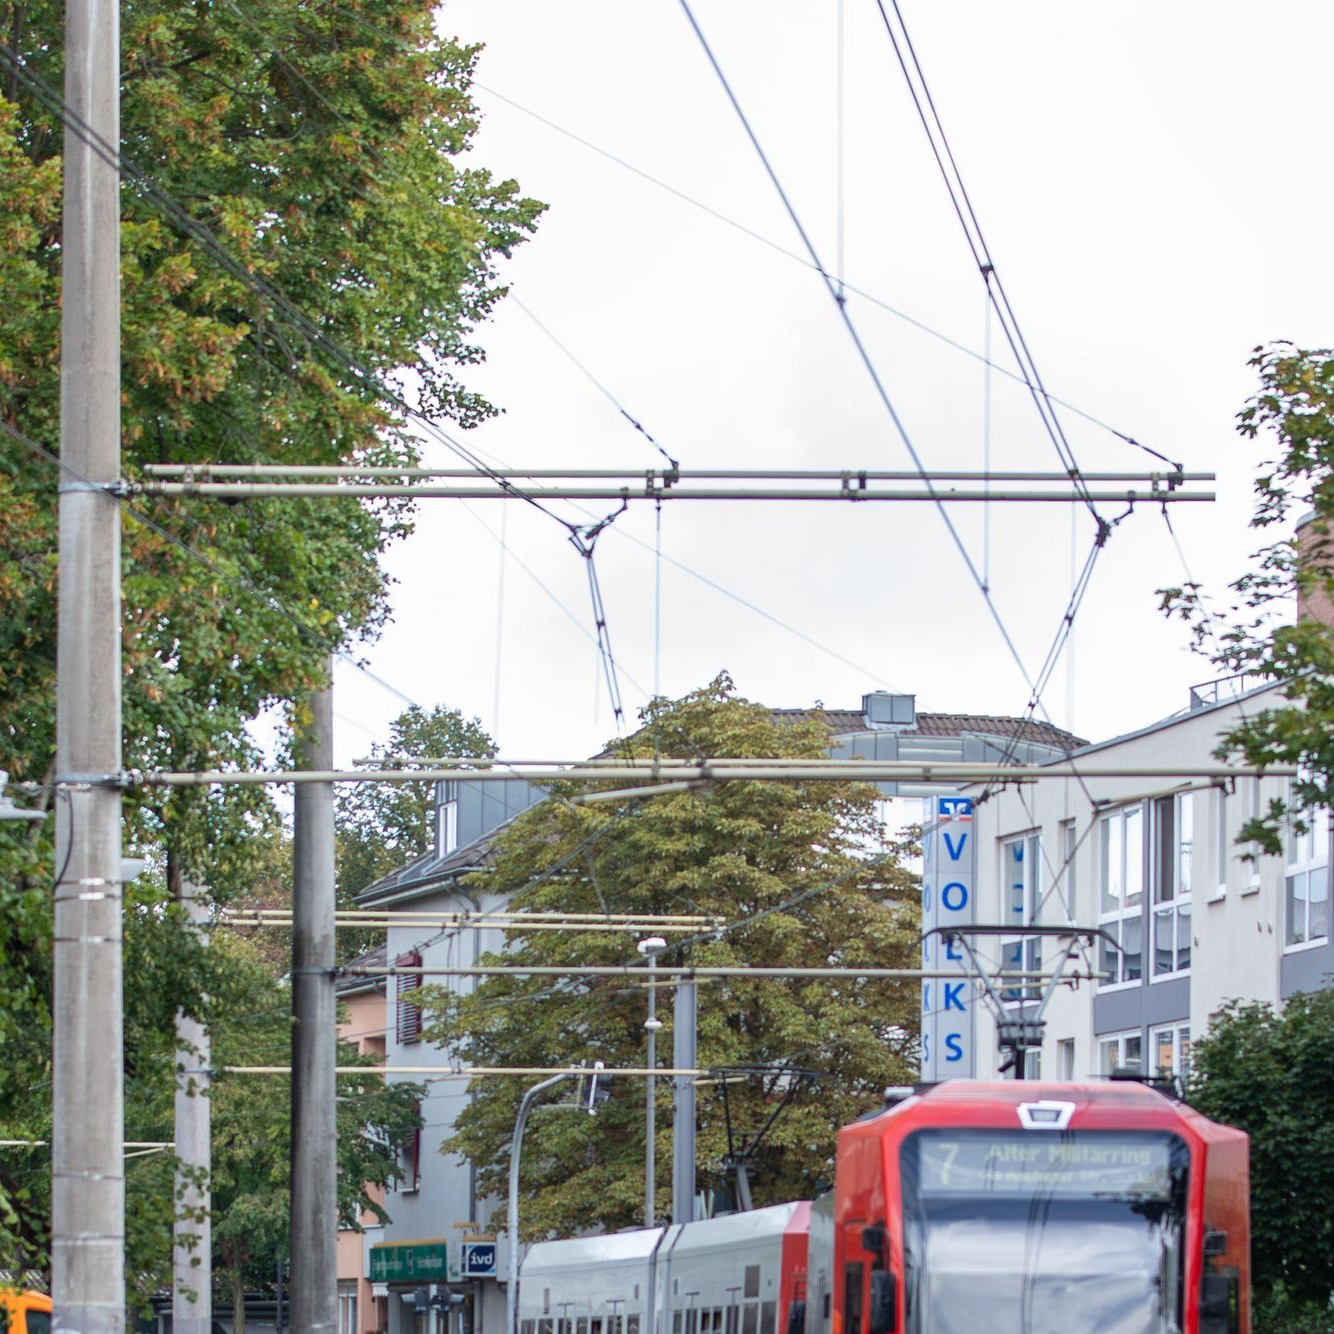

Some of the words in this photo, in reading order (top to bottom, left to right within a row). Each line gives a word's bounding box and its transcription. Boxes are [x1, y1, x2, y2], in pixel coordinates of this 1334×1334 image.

[941, 833, 968, 1062] VOLKS
[938, 1143, 959, 1185] 7
[986, 1144, 1040, 1163] Alter
[470, 1252, 493, 1265] ivd
